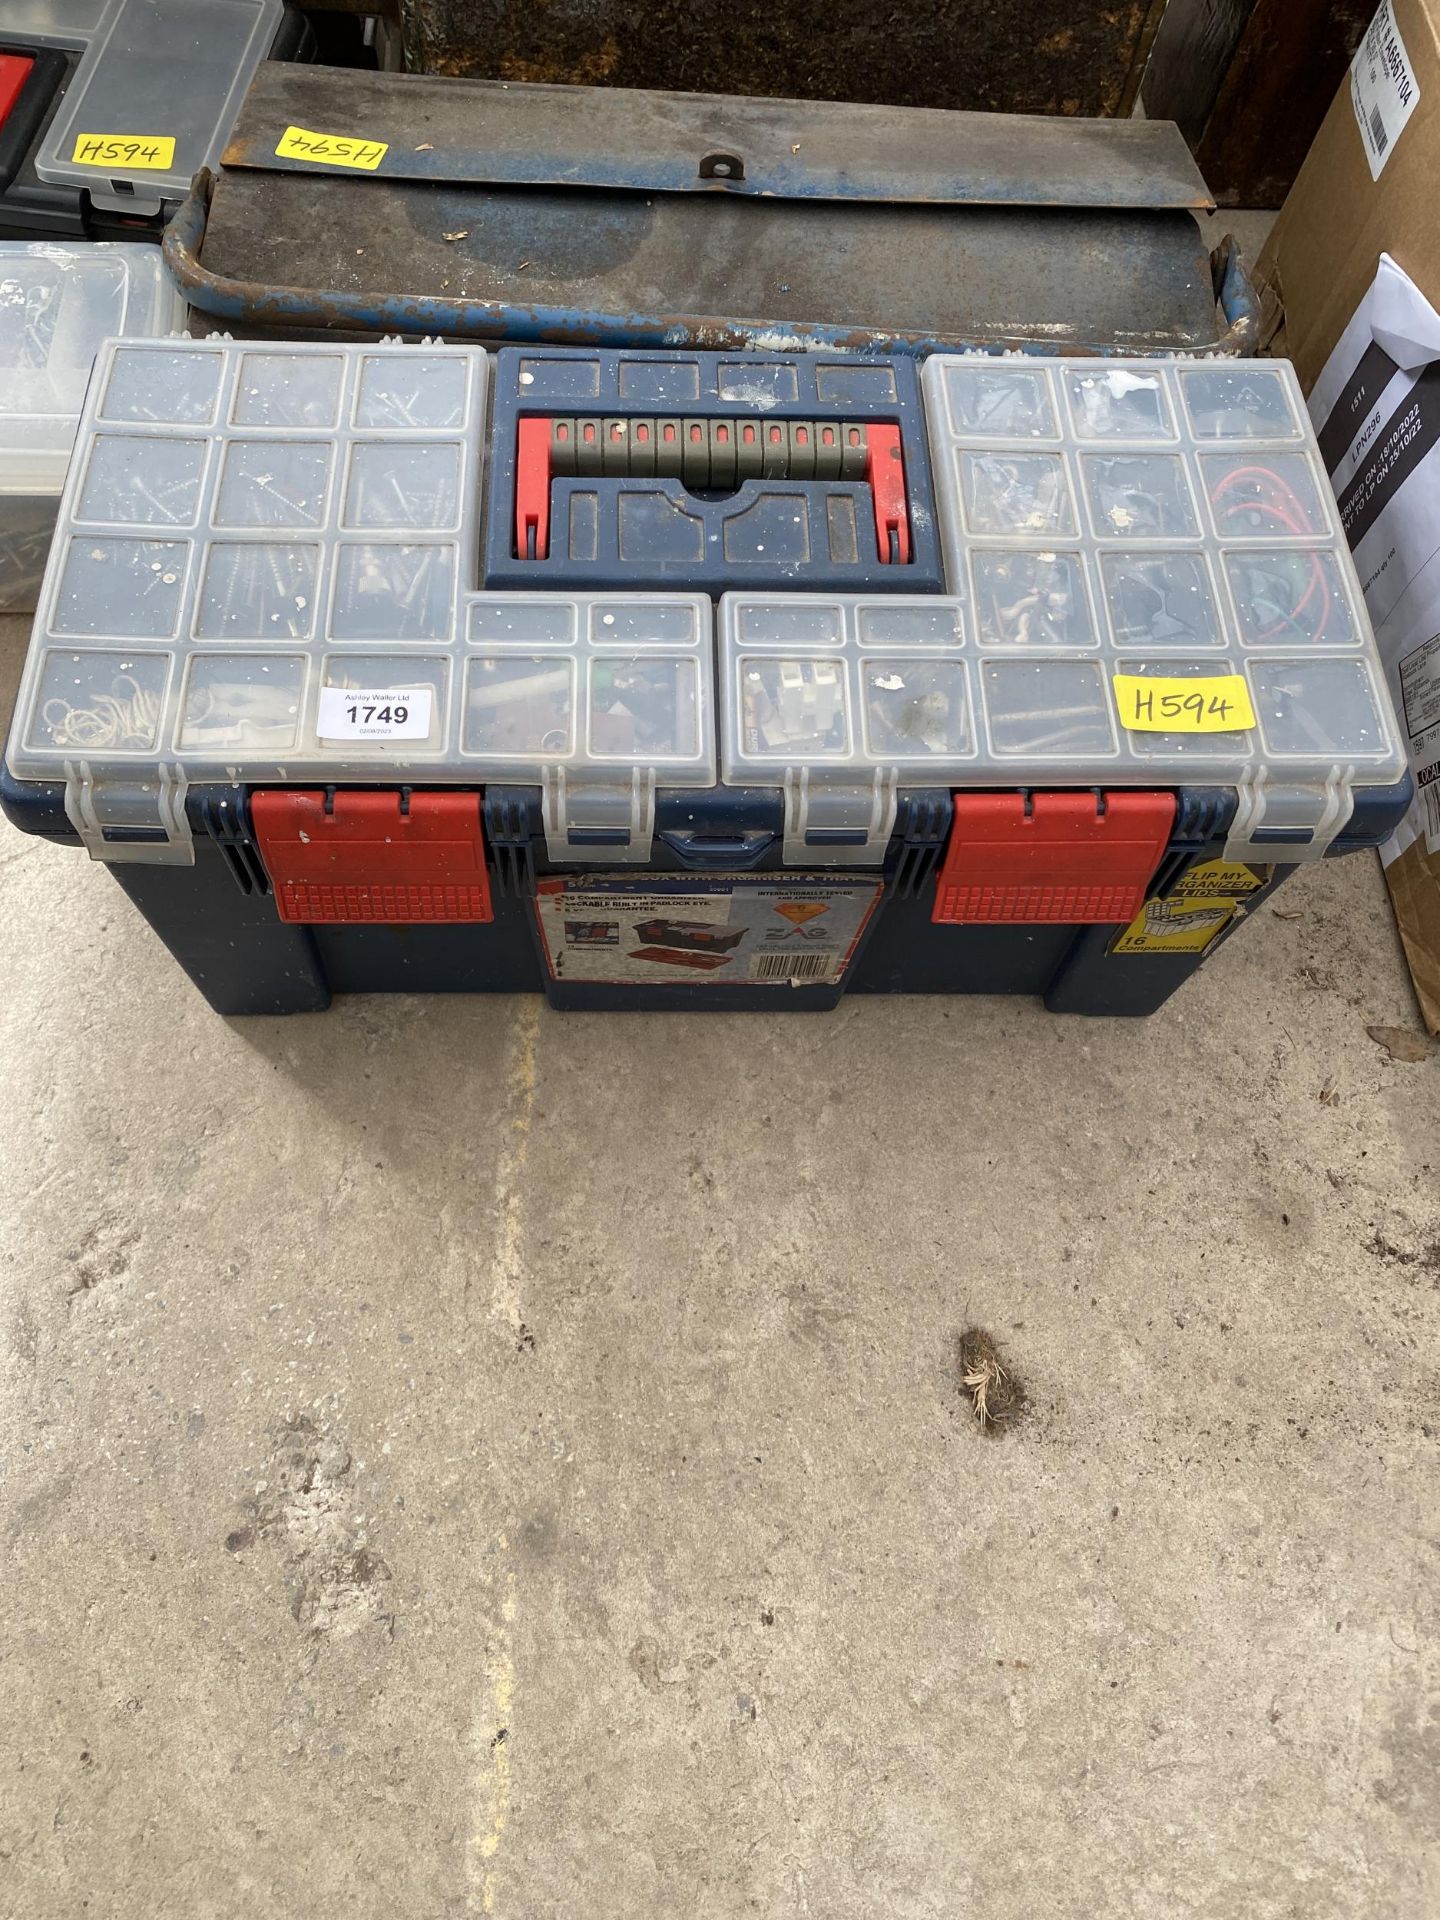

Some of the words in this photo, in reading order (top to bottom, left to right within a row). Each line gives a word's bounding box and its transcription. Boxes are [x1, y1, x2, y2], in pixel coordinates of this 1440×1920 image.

[1385, 37, 1413, 108] A6667104
[80, 141, 160, 162] H594
[290, 136, 383, 164] H594
[1350, 386, 1366, 413] 1511
[1351, 411, 1381, 463] LPN296
[1355, 498, 1365, 515] TO
[1365, 482, 1375, 501] LP
[1376, 466, 1389, 484] ON
[1389, 418, 1422, 467] 25/10/22
[1341, 483, 1365, 521] RRIVED
[1365, 463, 1377, 484] ON
[345, 694, 370, 702] Ashley
[1135, 689, 1234, 724] H594
[347, 706, 408, 724] 1749
[1177, 881, 1254, 889] RGANIZER
[1185, 872, 1219, 880] FLIP
[1221, 872, 1248, 880] MY
[1182, 889, 1221, 897] LIDS
[1124, 936, 1147, 946] 16
